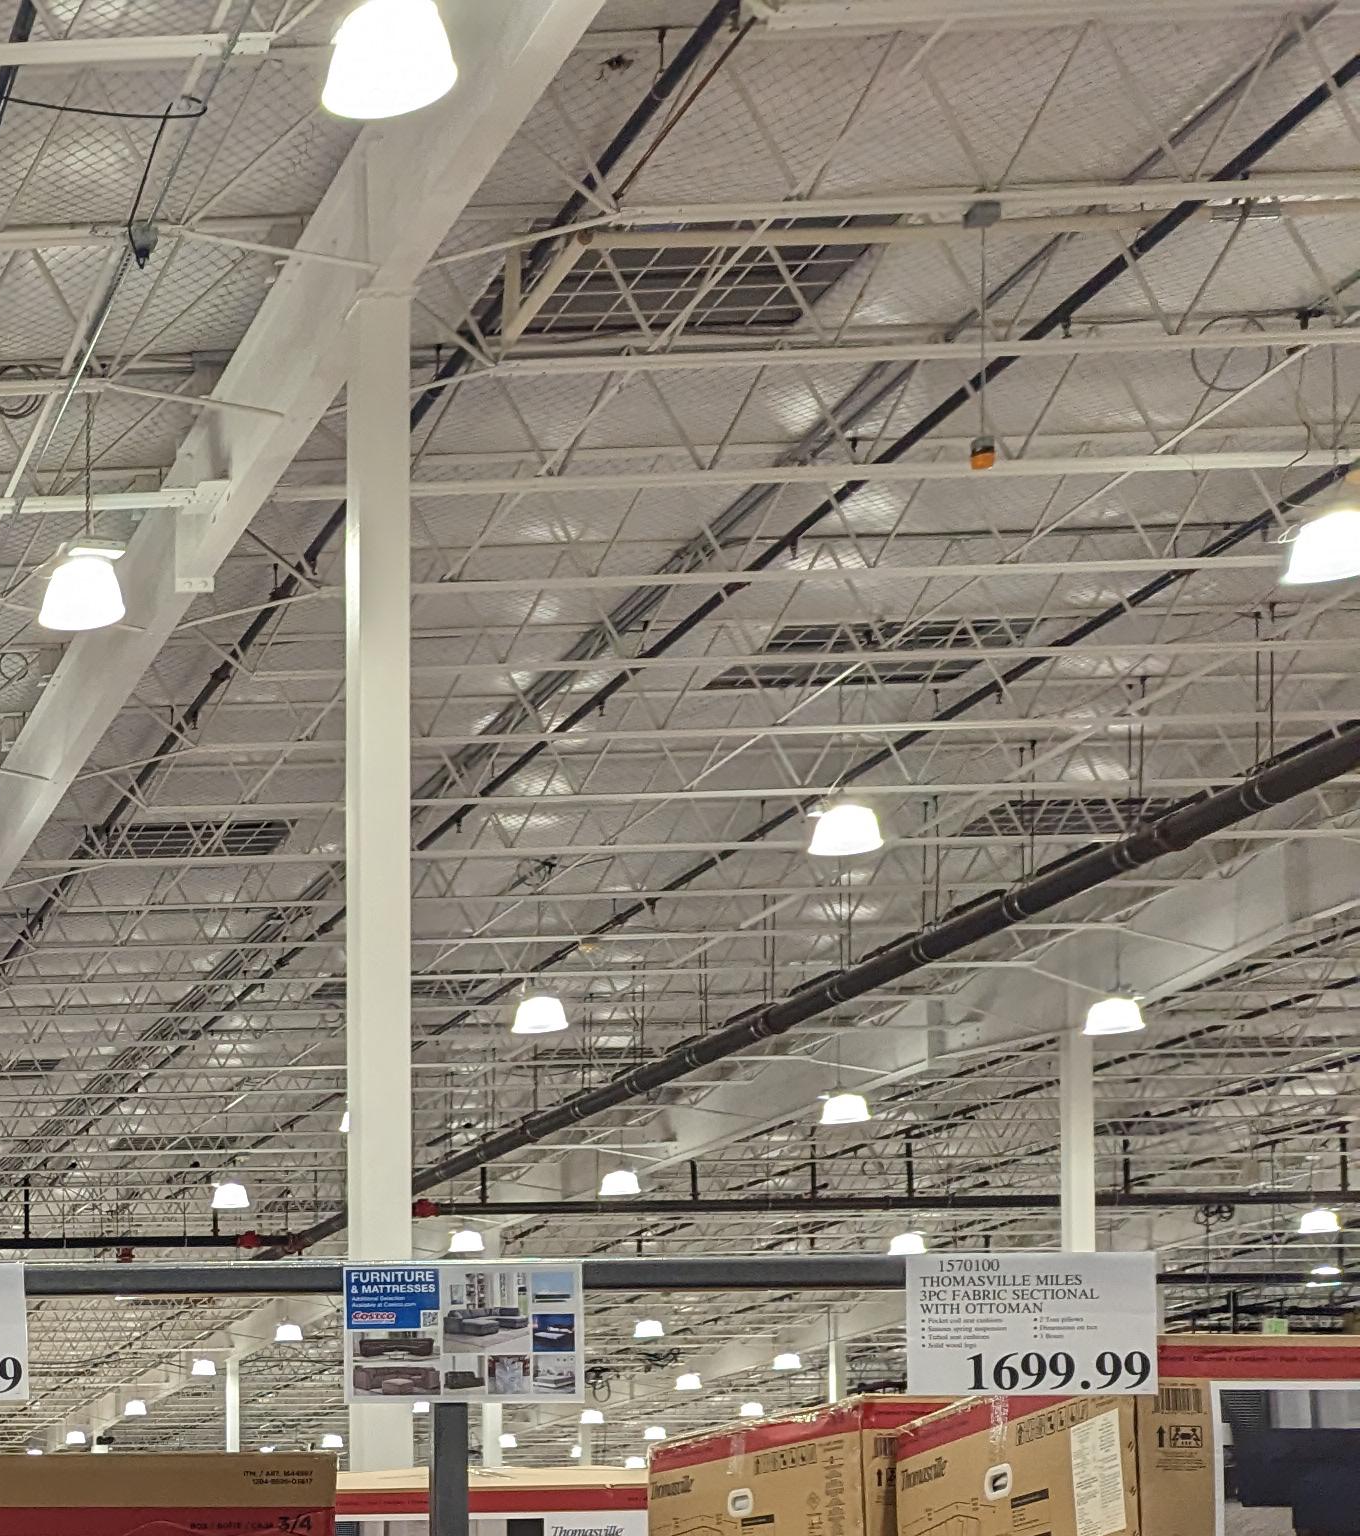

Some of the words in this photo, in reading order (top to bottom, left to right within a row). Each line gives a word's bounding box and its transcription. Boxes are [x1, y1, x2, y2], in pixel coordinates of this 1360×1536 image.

[939, 1258, 1000, 1272] 1570100
[351, 1271, 435, 1283] FURNITURE
[920, 1275, 1030, 1288] THOMASVILLE
[1036, 1274, 1082, 1286] MILES
[351, 1285, 359, 1294] &
[362, 1284, 436, 1294] MATTRESSES
[920, 1290, 947, 1302] 3PC
[951, 1289, 1008, 1301] FABRIC
[1012, 1288, 1100, 1300] SECTIONAL
[352, 1311, 396, 1320] COSTCO
[920, 1303, 961, 1315] WITH
[965, 1302, 1044, 1314] OTTOMAN
[966, 1351, 1151, 1391] 1699.99
[278, 1515, 312, 1534] 3/4
